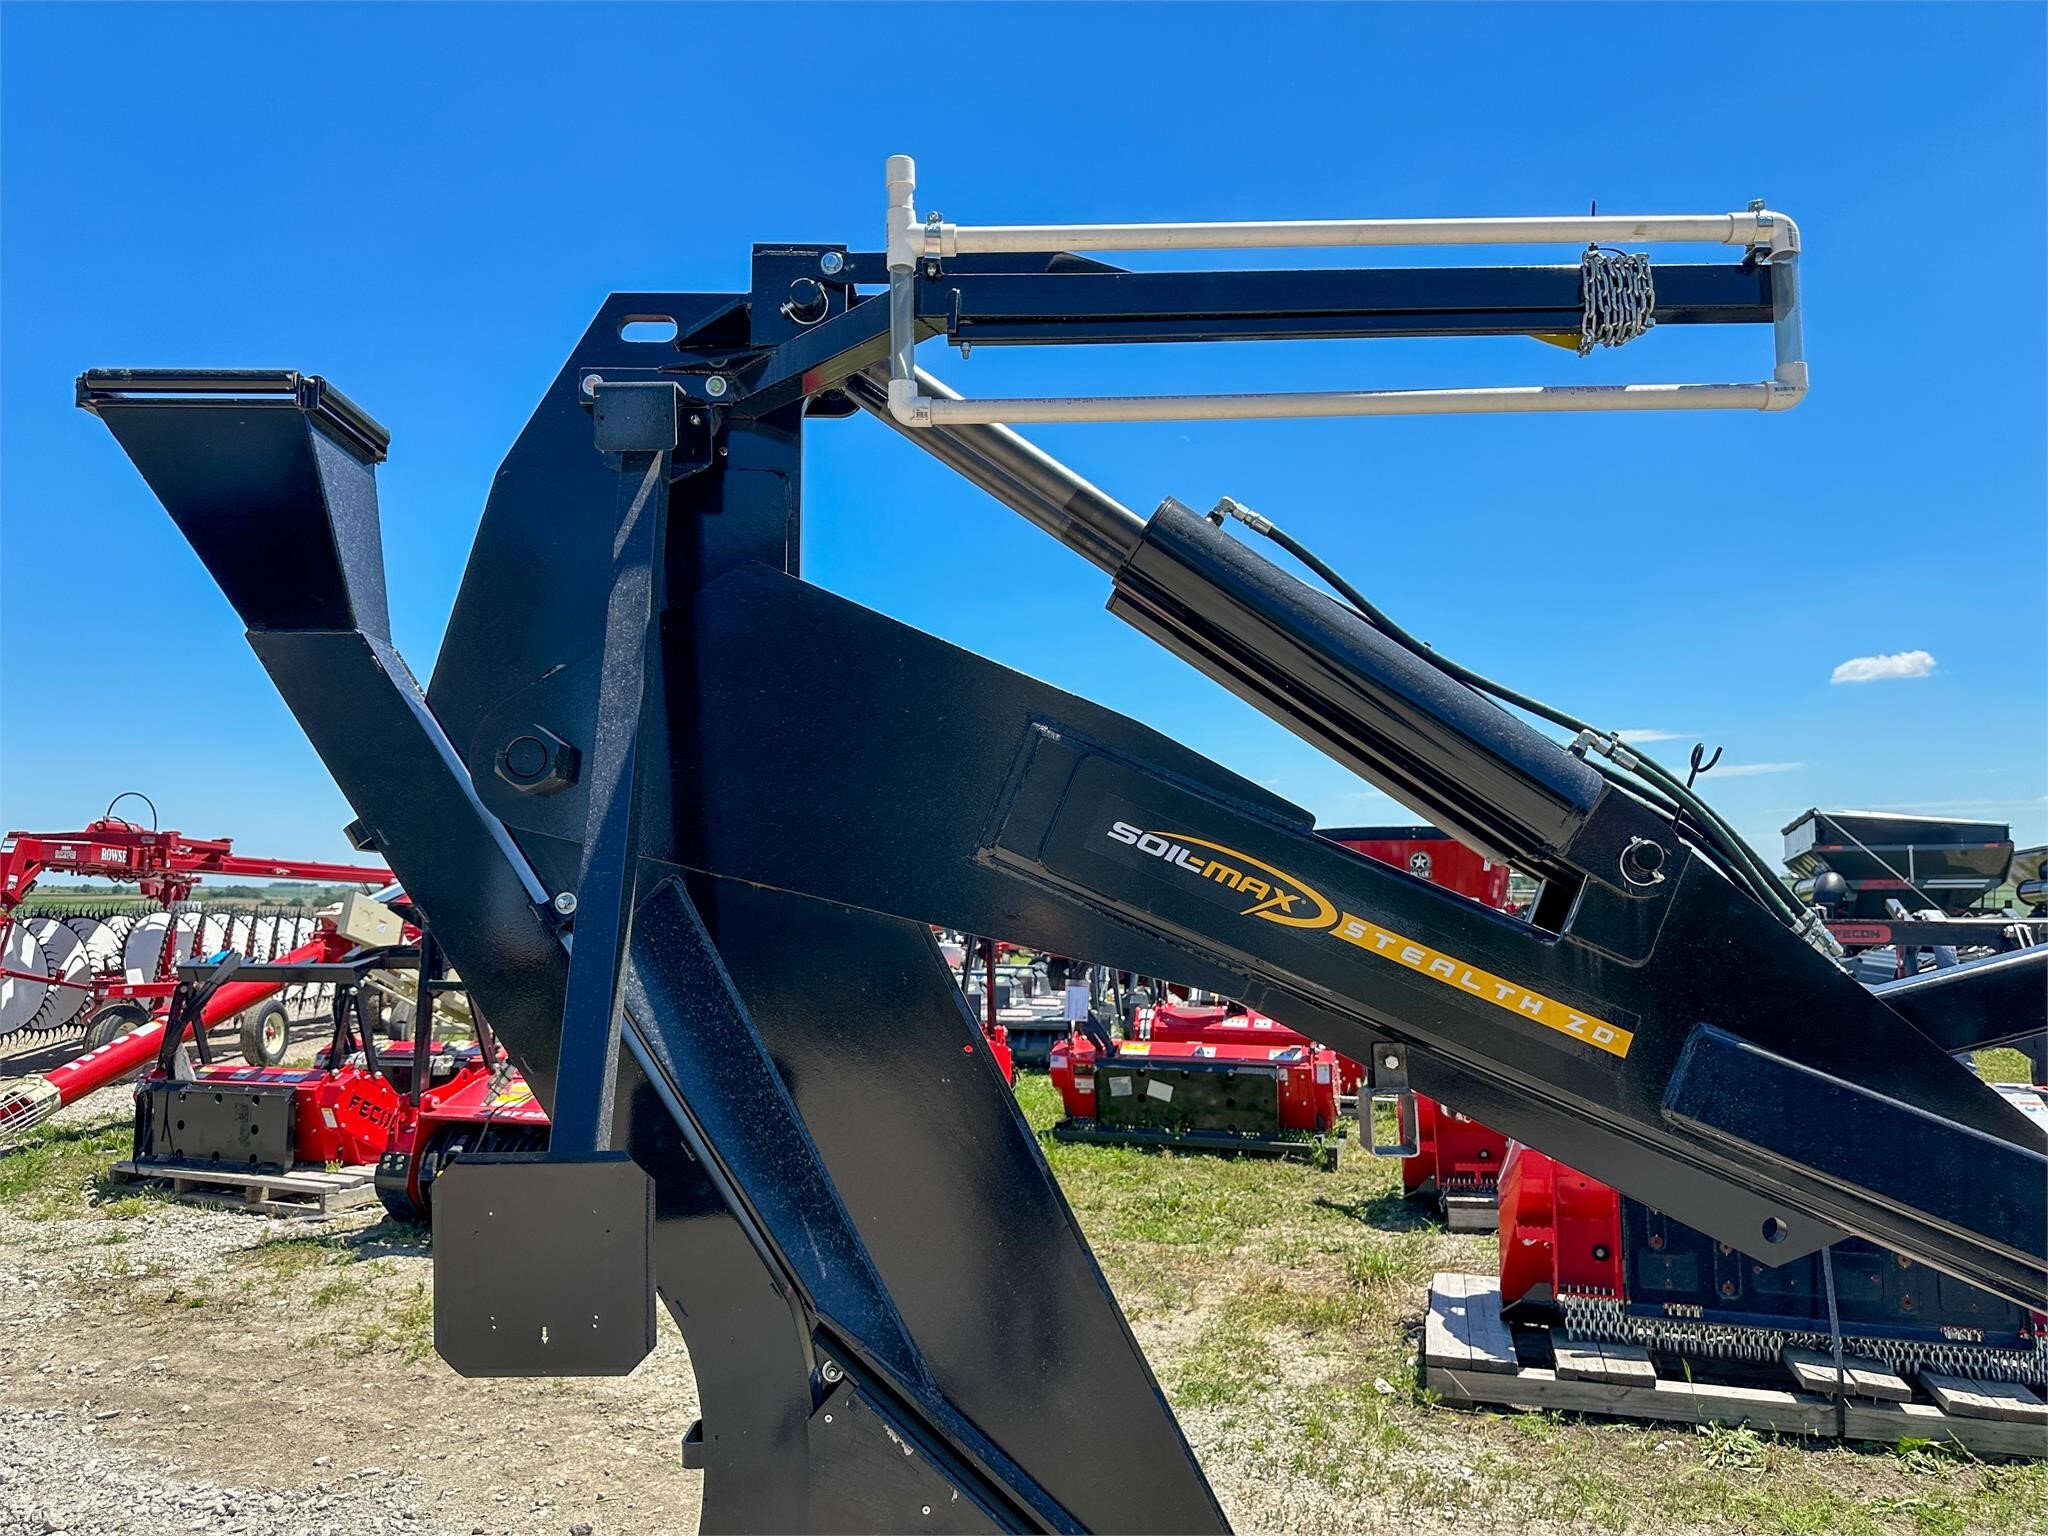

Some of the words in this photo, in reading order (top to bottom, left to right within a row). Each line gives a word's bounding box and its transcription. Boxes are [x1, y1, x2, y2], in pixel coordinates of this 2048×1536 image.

[101, 847, 128, 863] ROWSE
[1107, 821, 1301, 916] SOIL-MAX
[1344, 921, 1544, 1015] STEALTH
